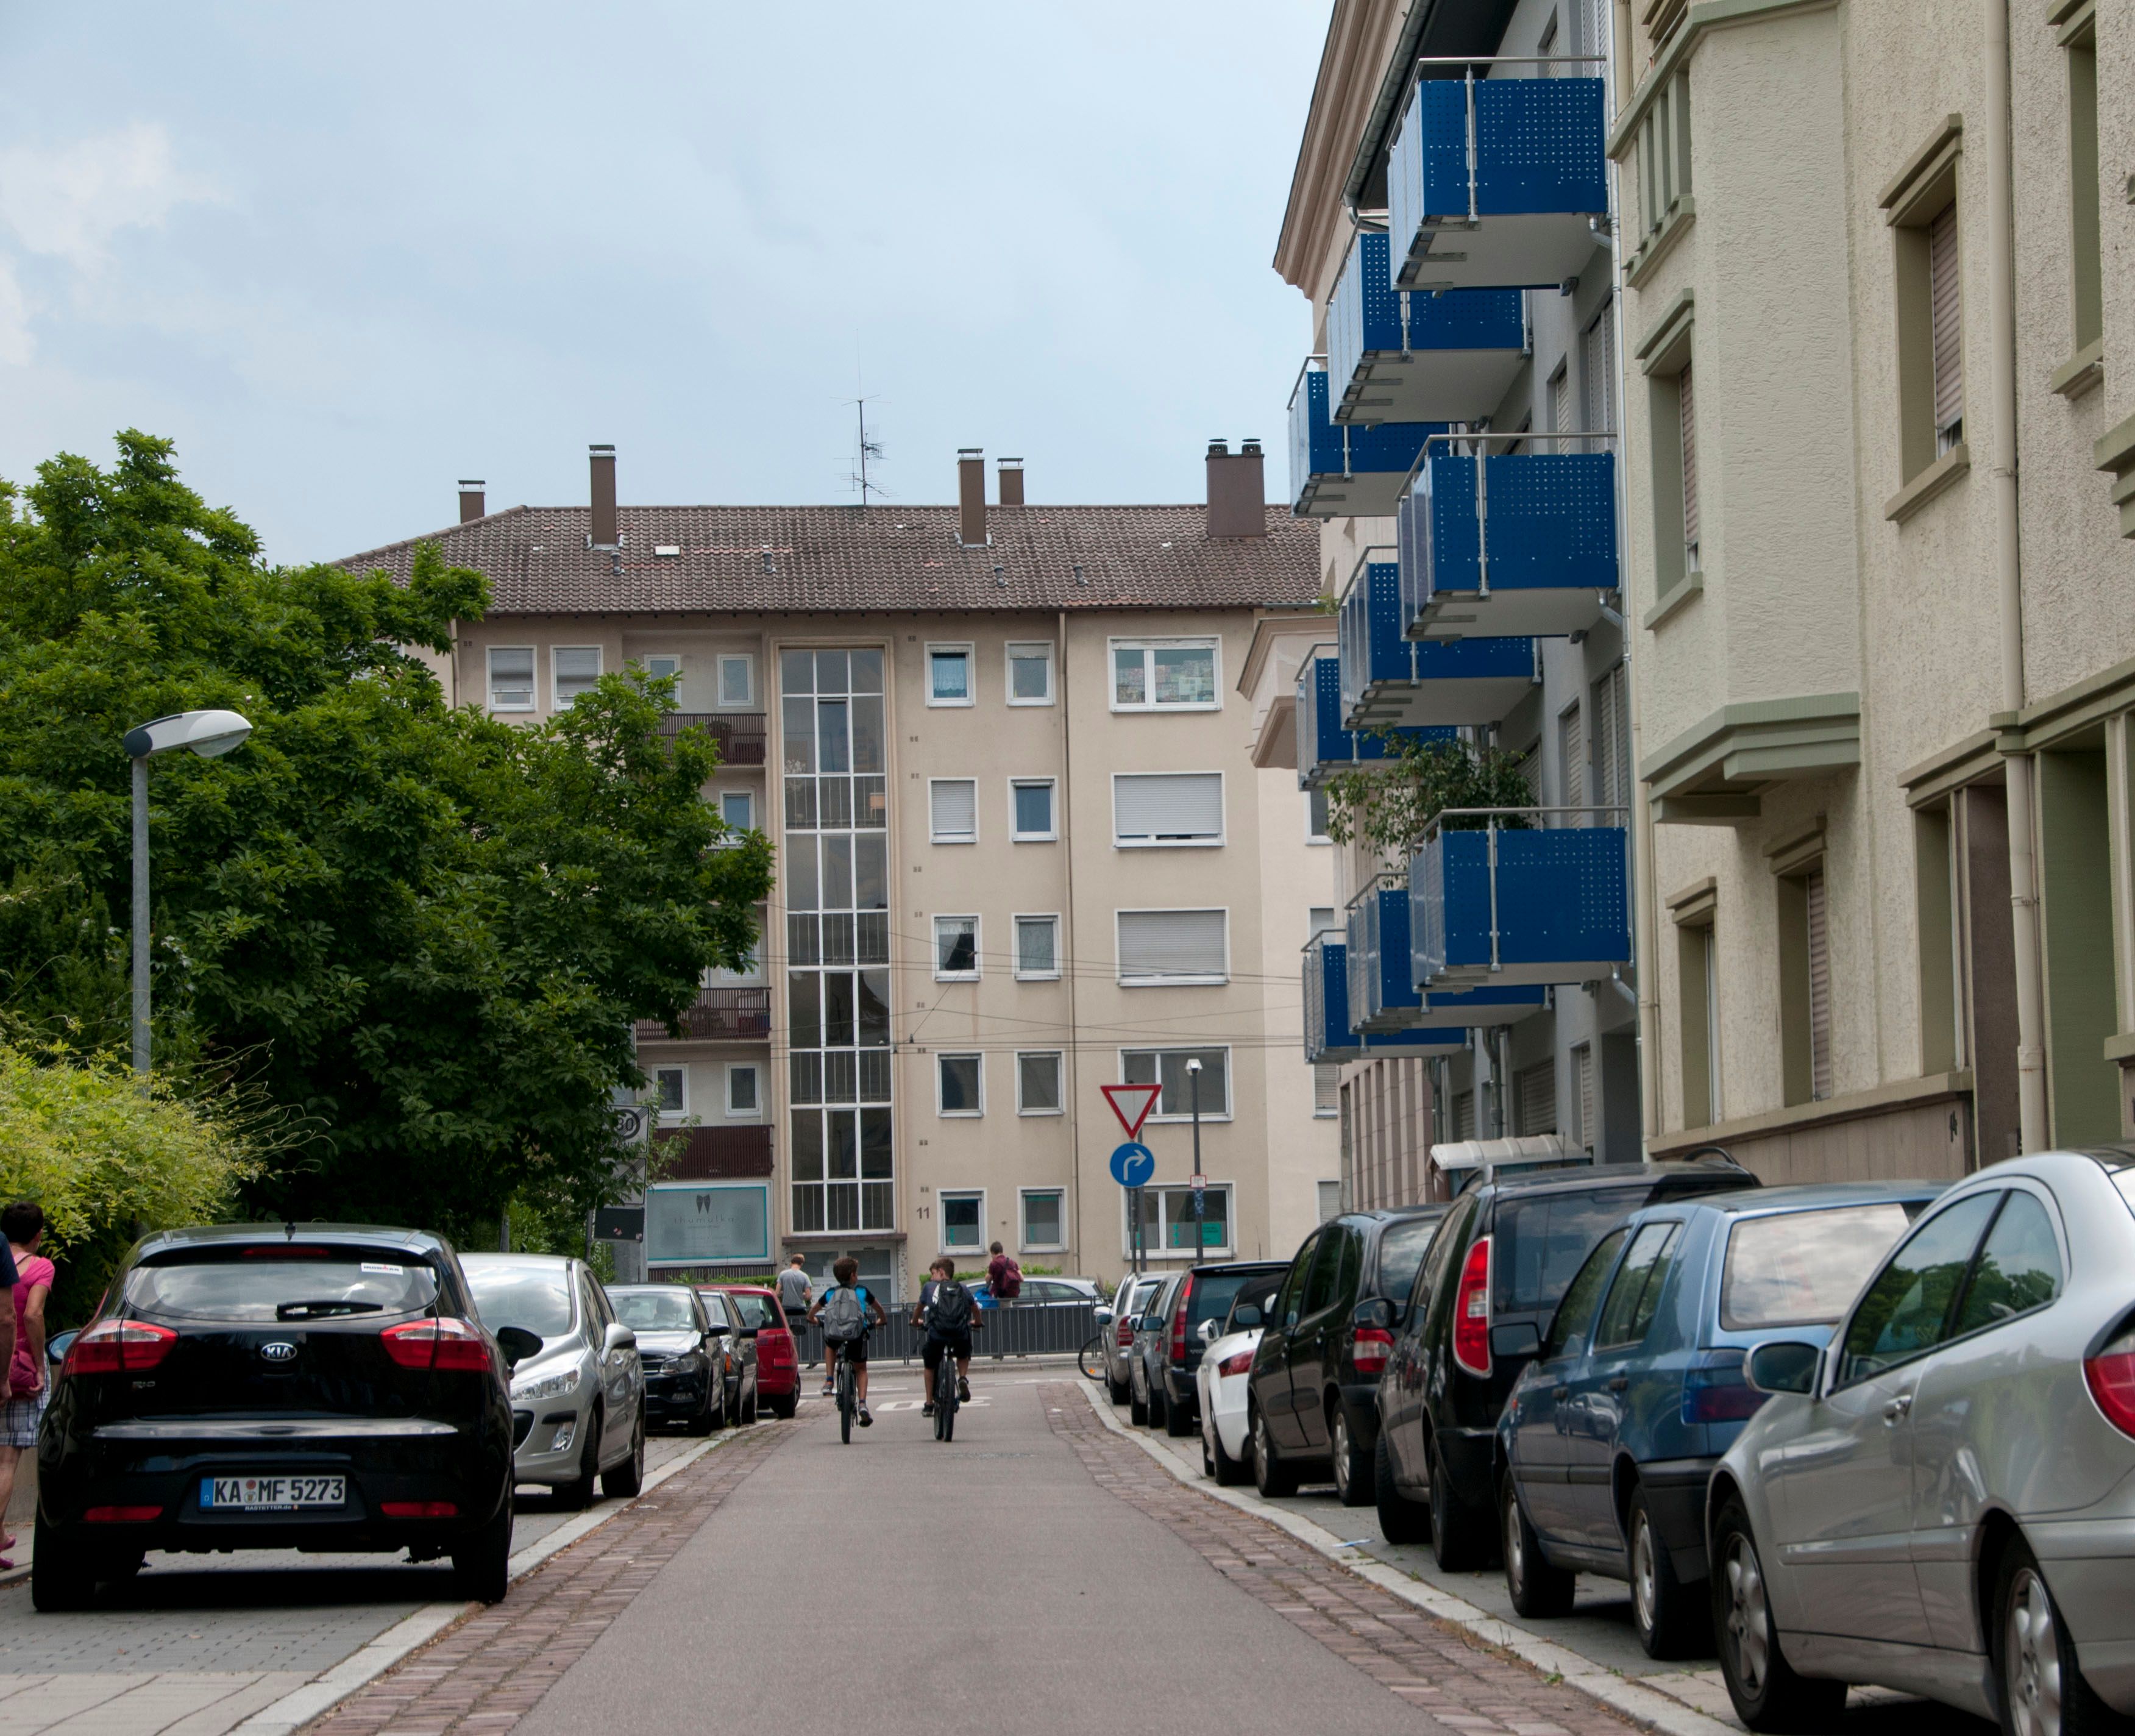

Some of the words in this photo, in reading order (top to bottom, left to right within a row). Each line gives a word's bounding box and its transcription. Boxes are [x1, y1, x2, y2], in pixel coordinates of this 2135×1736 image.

[617, 1117, 634, 1131] 30
[917, 1207, 929, 1219] 11
[267, 1347, 291, 1357] KIA
[215, 1481, 241, 1503] KA
[258, 1480, 285, 1502] MF
[291, 1479, 343, 1501] 5273
